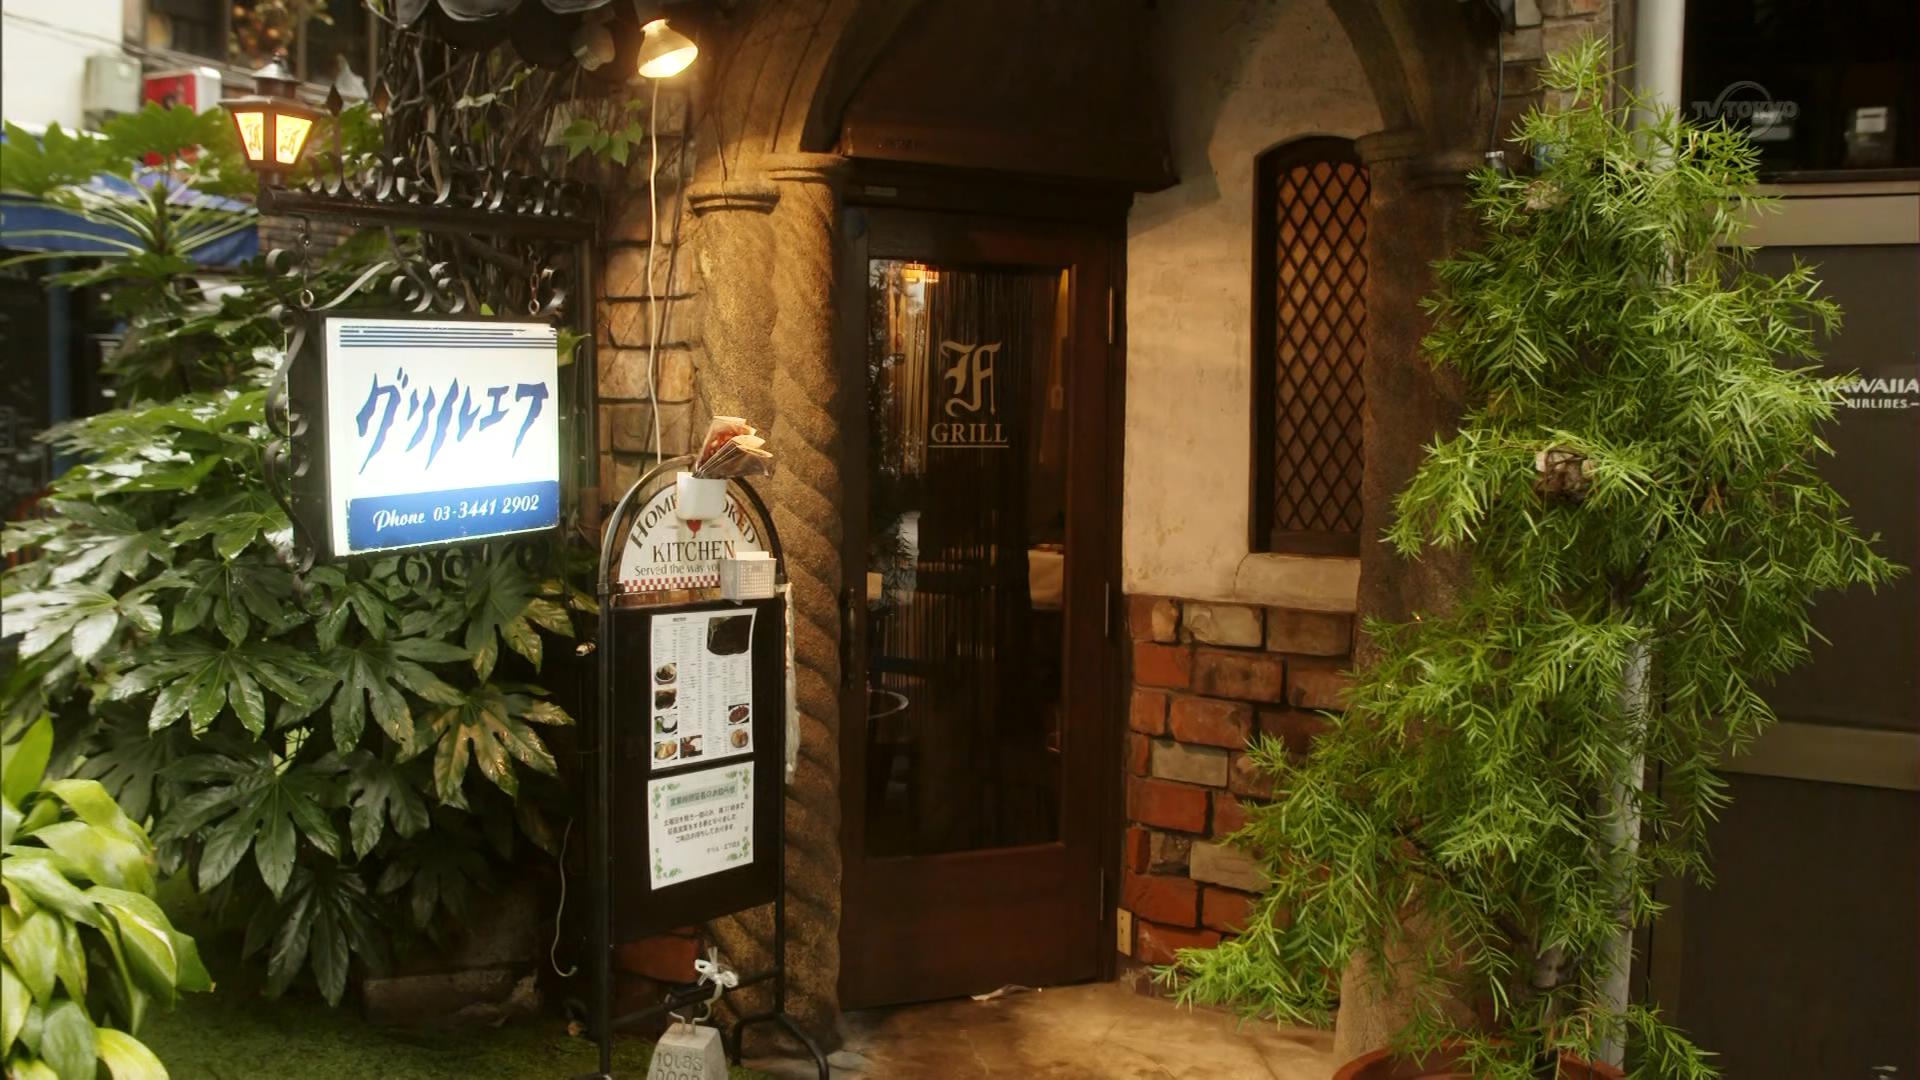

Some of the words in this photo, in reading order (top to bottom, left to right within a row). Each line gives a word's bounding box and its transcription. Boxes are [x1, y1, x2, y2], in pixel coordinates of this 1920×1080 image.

[356, 367, 549, 475] グリルエフ
[931, 423, 1008, 443] GRILL
[373, 509, 426, 532] Phone
[433, 499, 496, 522] 03-3441
[501, 494, 540, 514] 2902
[653, 540, 735, 563] KITCHEN
[634, 564, 667, 576] Served
[670, 564, 685, 574] the
[687, 564, 704, 574] way
